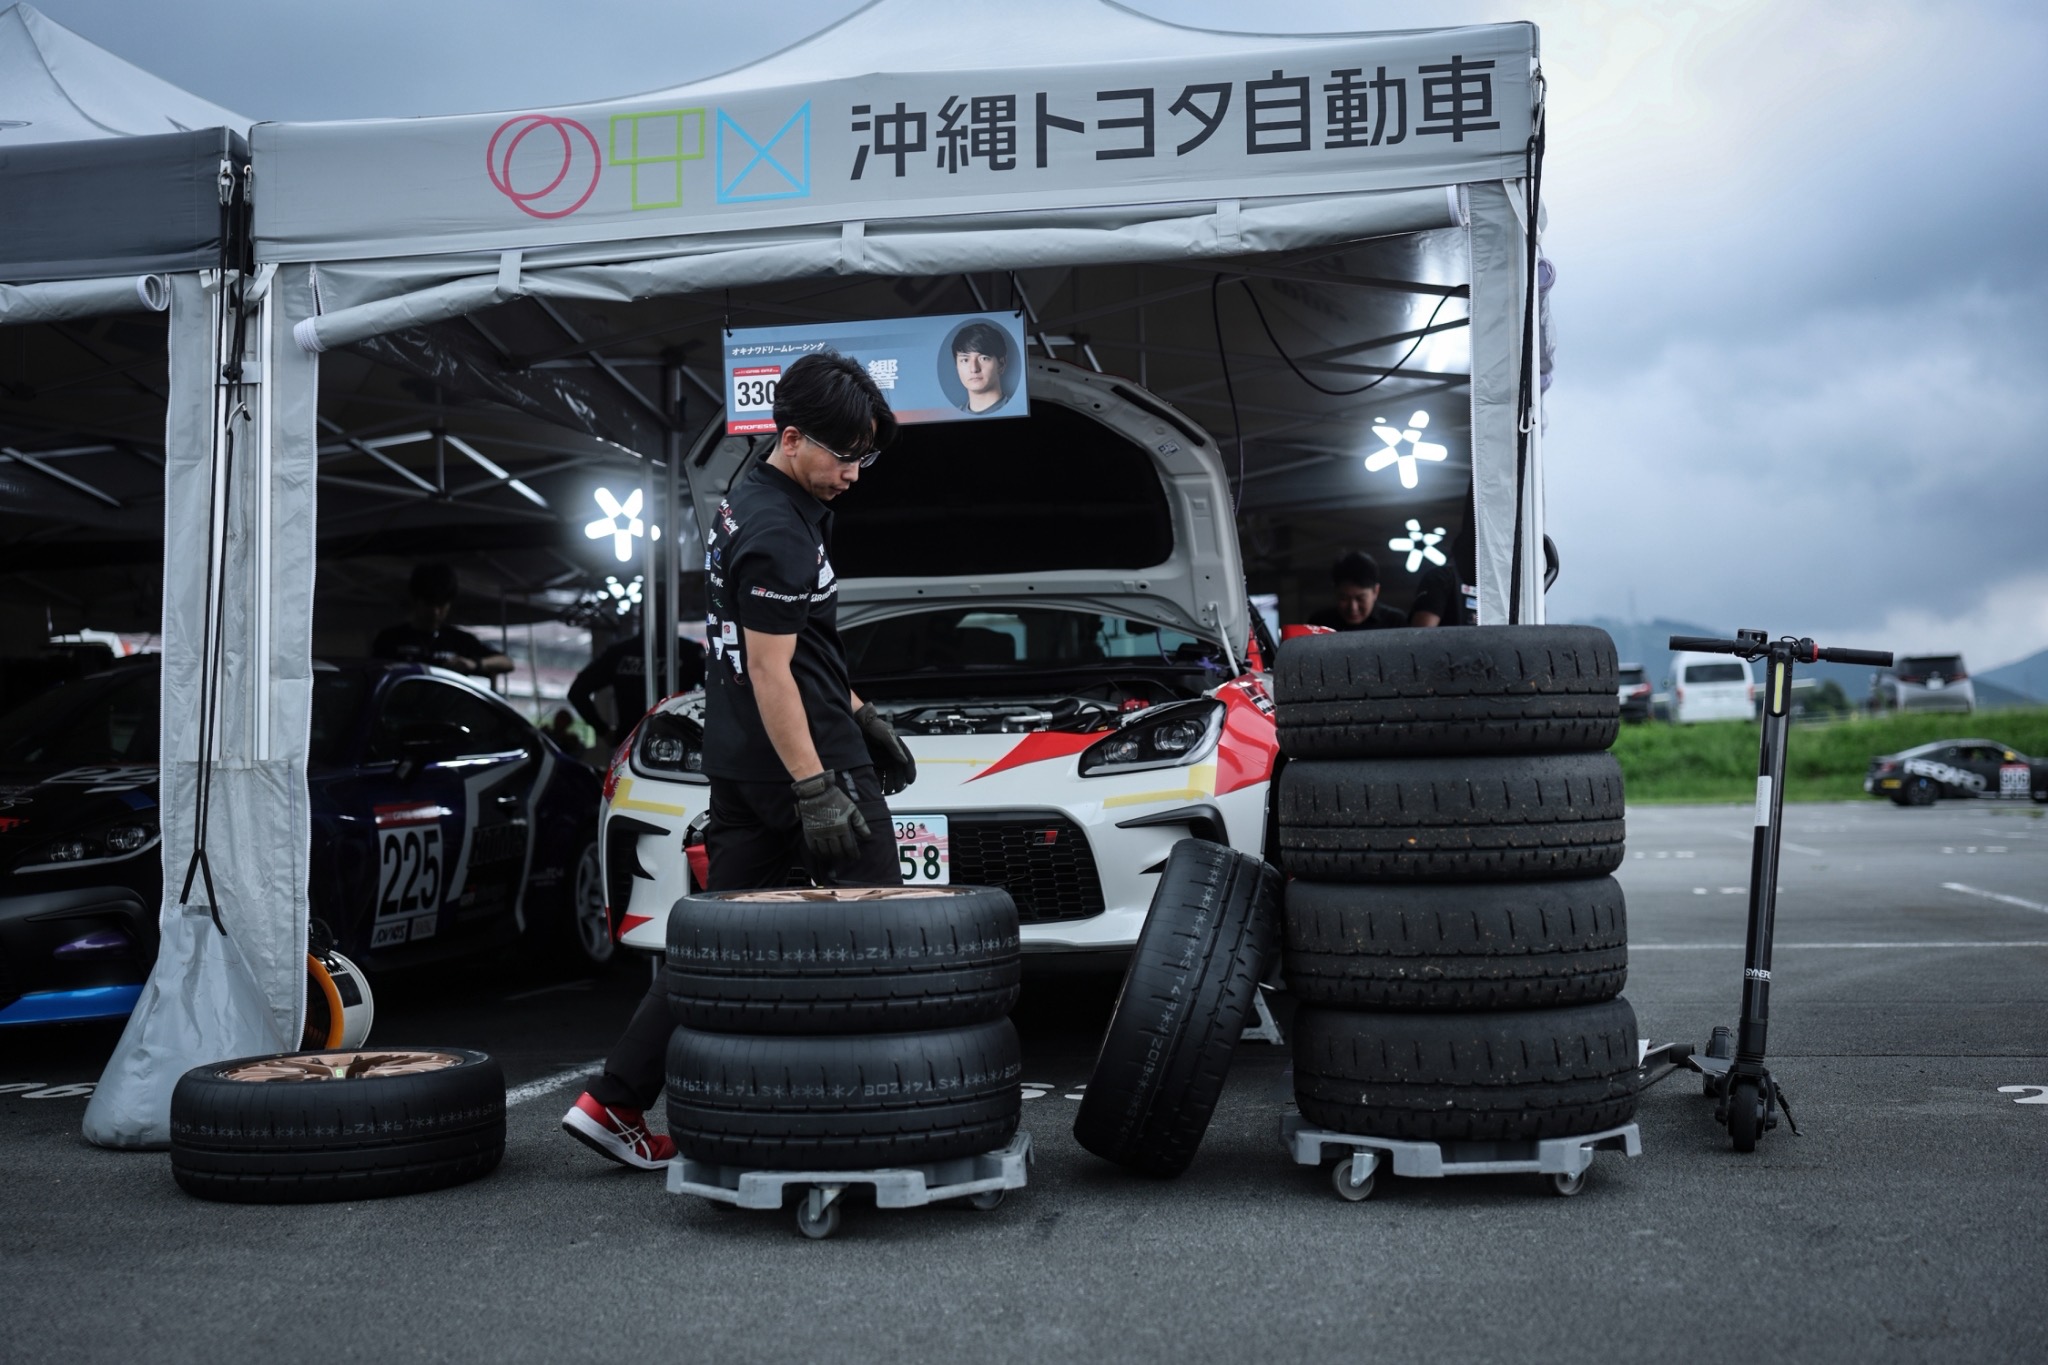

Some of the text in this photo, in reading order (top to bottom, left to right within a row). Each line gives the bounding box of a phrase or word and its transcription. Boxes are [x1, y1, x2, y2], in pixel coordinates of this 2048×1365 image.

[850, 54, 1501, 181] 沖縄トヨタ自動車
[731, 341, 826, 356] オキナワドリームレーシング
[737, 380, 777, 407] 330
[765, 591, 798, 602] Garage
[378, 829, 440, 917] 225
[899, 845, 941, 880] 58
